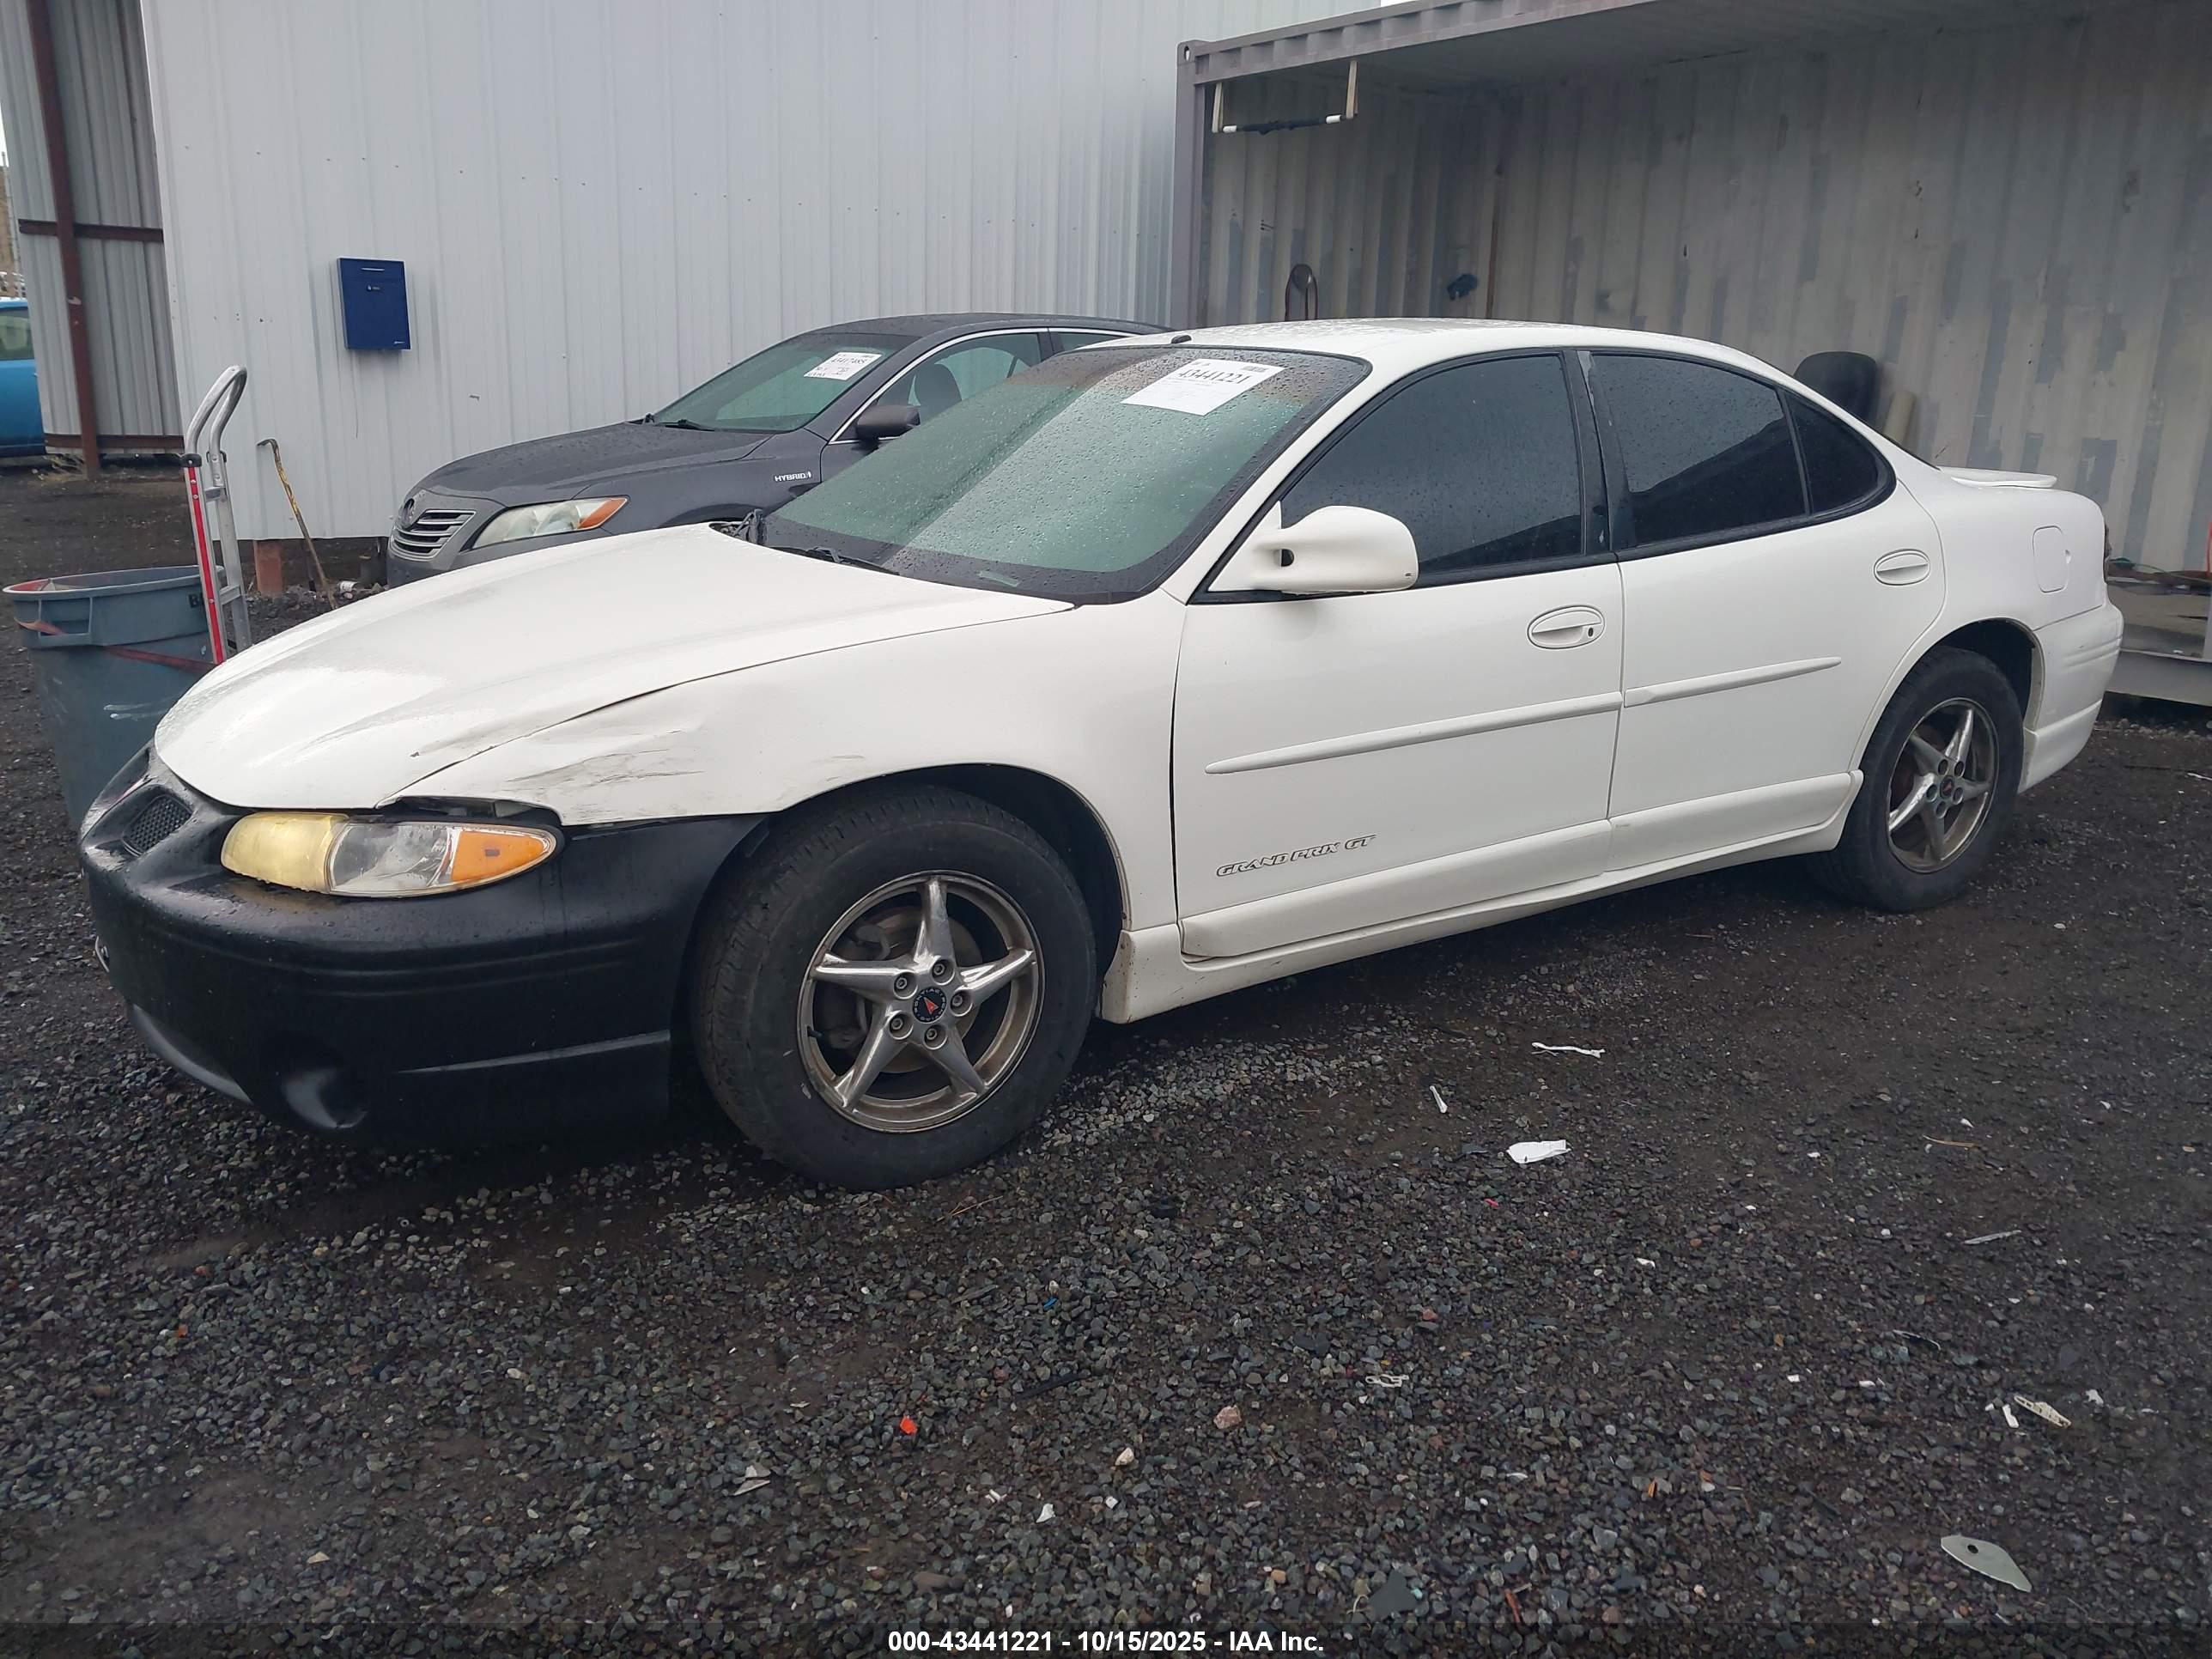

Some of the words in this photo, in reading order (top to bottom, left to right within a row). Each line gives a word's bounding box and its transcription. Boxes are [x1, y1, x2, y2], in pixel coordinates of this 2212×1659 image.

[1177, 369, 1253, 384] 43441221
[774, 472, 807, 482] HYBRID
[1216, 853, 1289, 878] GRAND
[1291, 842, 1340, 862] PRIX
[1345, 834, 1377, 850] GT
